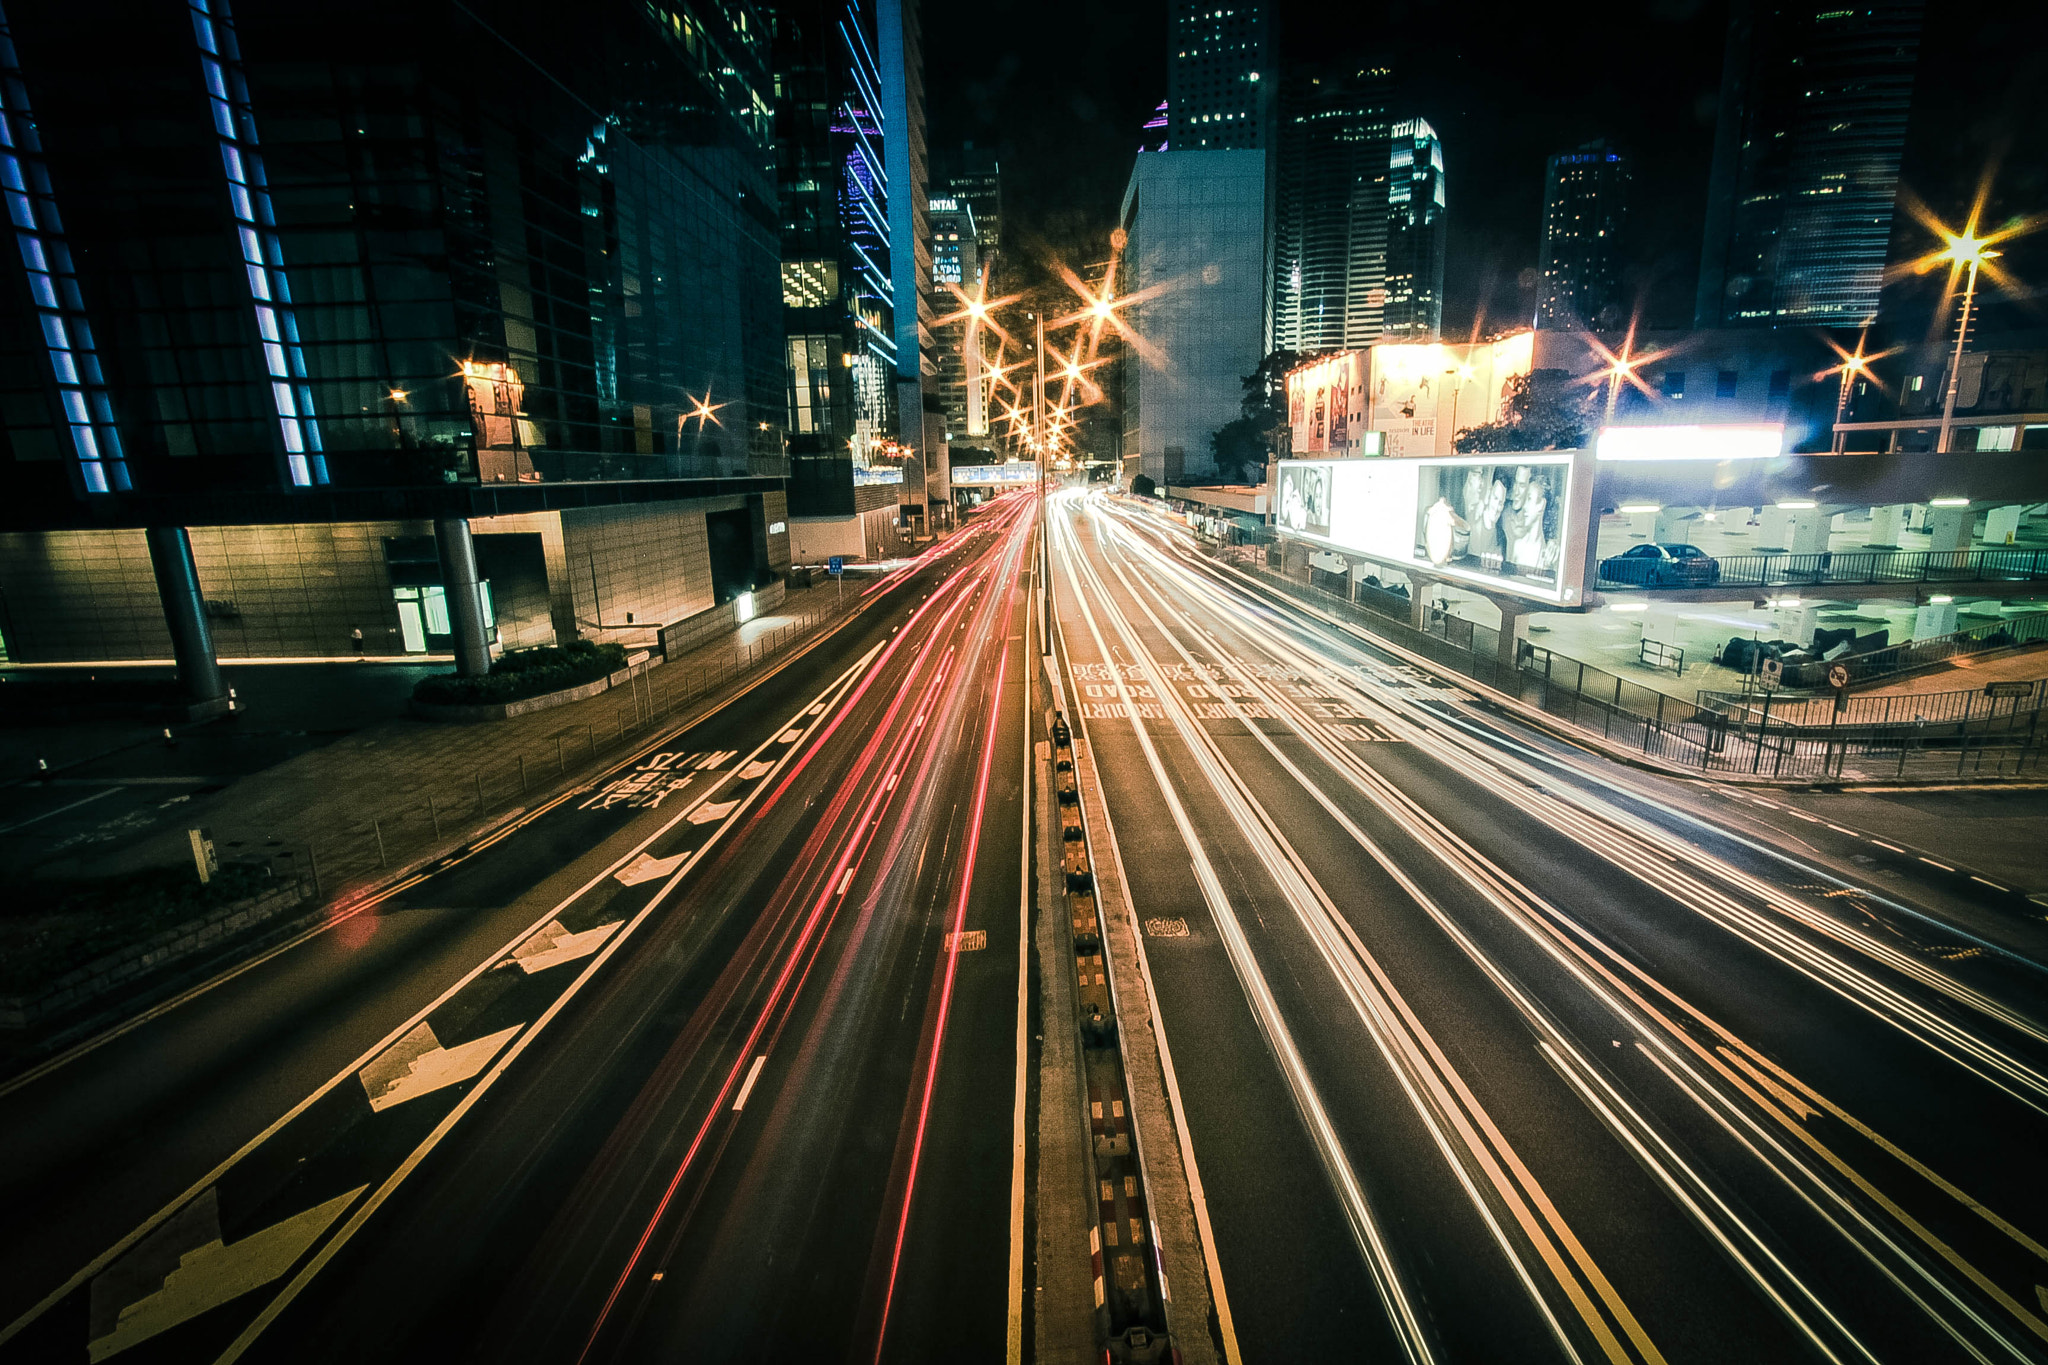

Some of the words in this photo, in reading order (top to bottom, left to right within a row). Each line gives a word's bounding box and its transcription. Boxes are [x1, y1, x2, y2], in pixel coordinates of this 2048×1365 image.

[1412, 427, 1418, 435] IN
[1421, 427, 1434, 435] LIFE
[1085, 684, 1156, 699] ROAD
[636, 749, 738, 771] SLOW
